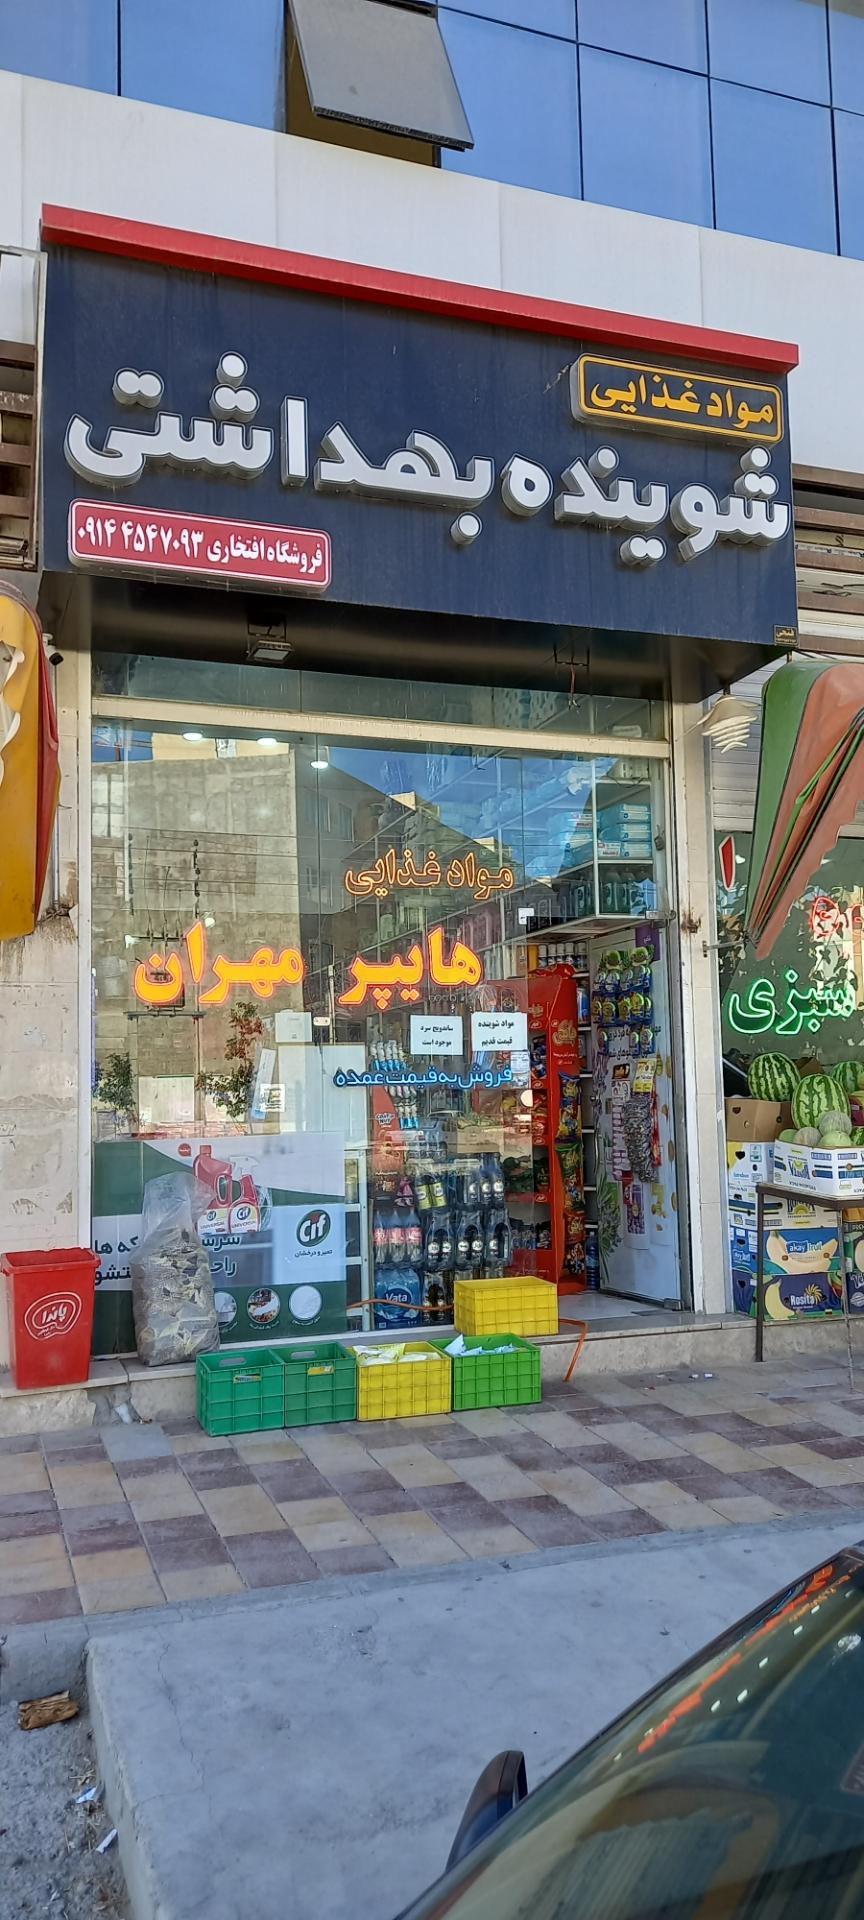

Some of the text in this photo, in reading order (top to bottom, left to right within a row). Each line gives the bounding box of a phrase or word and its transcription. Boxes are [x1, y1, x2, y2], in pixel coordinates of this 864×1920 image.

[590, 374, 775, 429] مواد غذایی
[62, 351, 792, 566] شوینده بهداشتی
[77, 516, 323, 574] فروشگاه افتخاری ۰۹۱۴ ۴۵۴۷۰۹۳
[345, 845, 514, 900] مواد غذایی
[133, 920, 484, 1010] هایپر مهران
[728, 969, 856, 1035] سبزی
[420, 1025, 431, 1033] سرد
[478, 1019, 515, 1029] مواد شوینده
[496, 1036, 513, 1045] قیمت
[334, 1064, 513, 1088] فروش به قیمت عمده
[299, 1213, 327, 1243] Cif
[94, 1239, 113, 1254] ها
[384, 1292, 408, 1302] Vata
[790, 1295, 815, 1306] Rosita
[41, 1303, 68, 1325] پاندا
